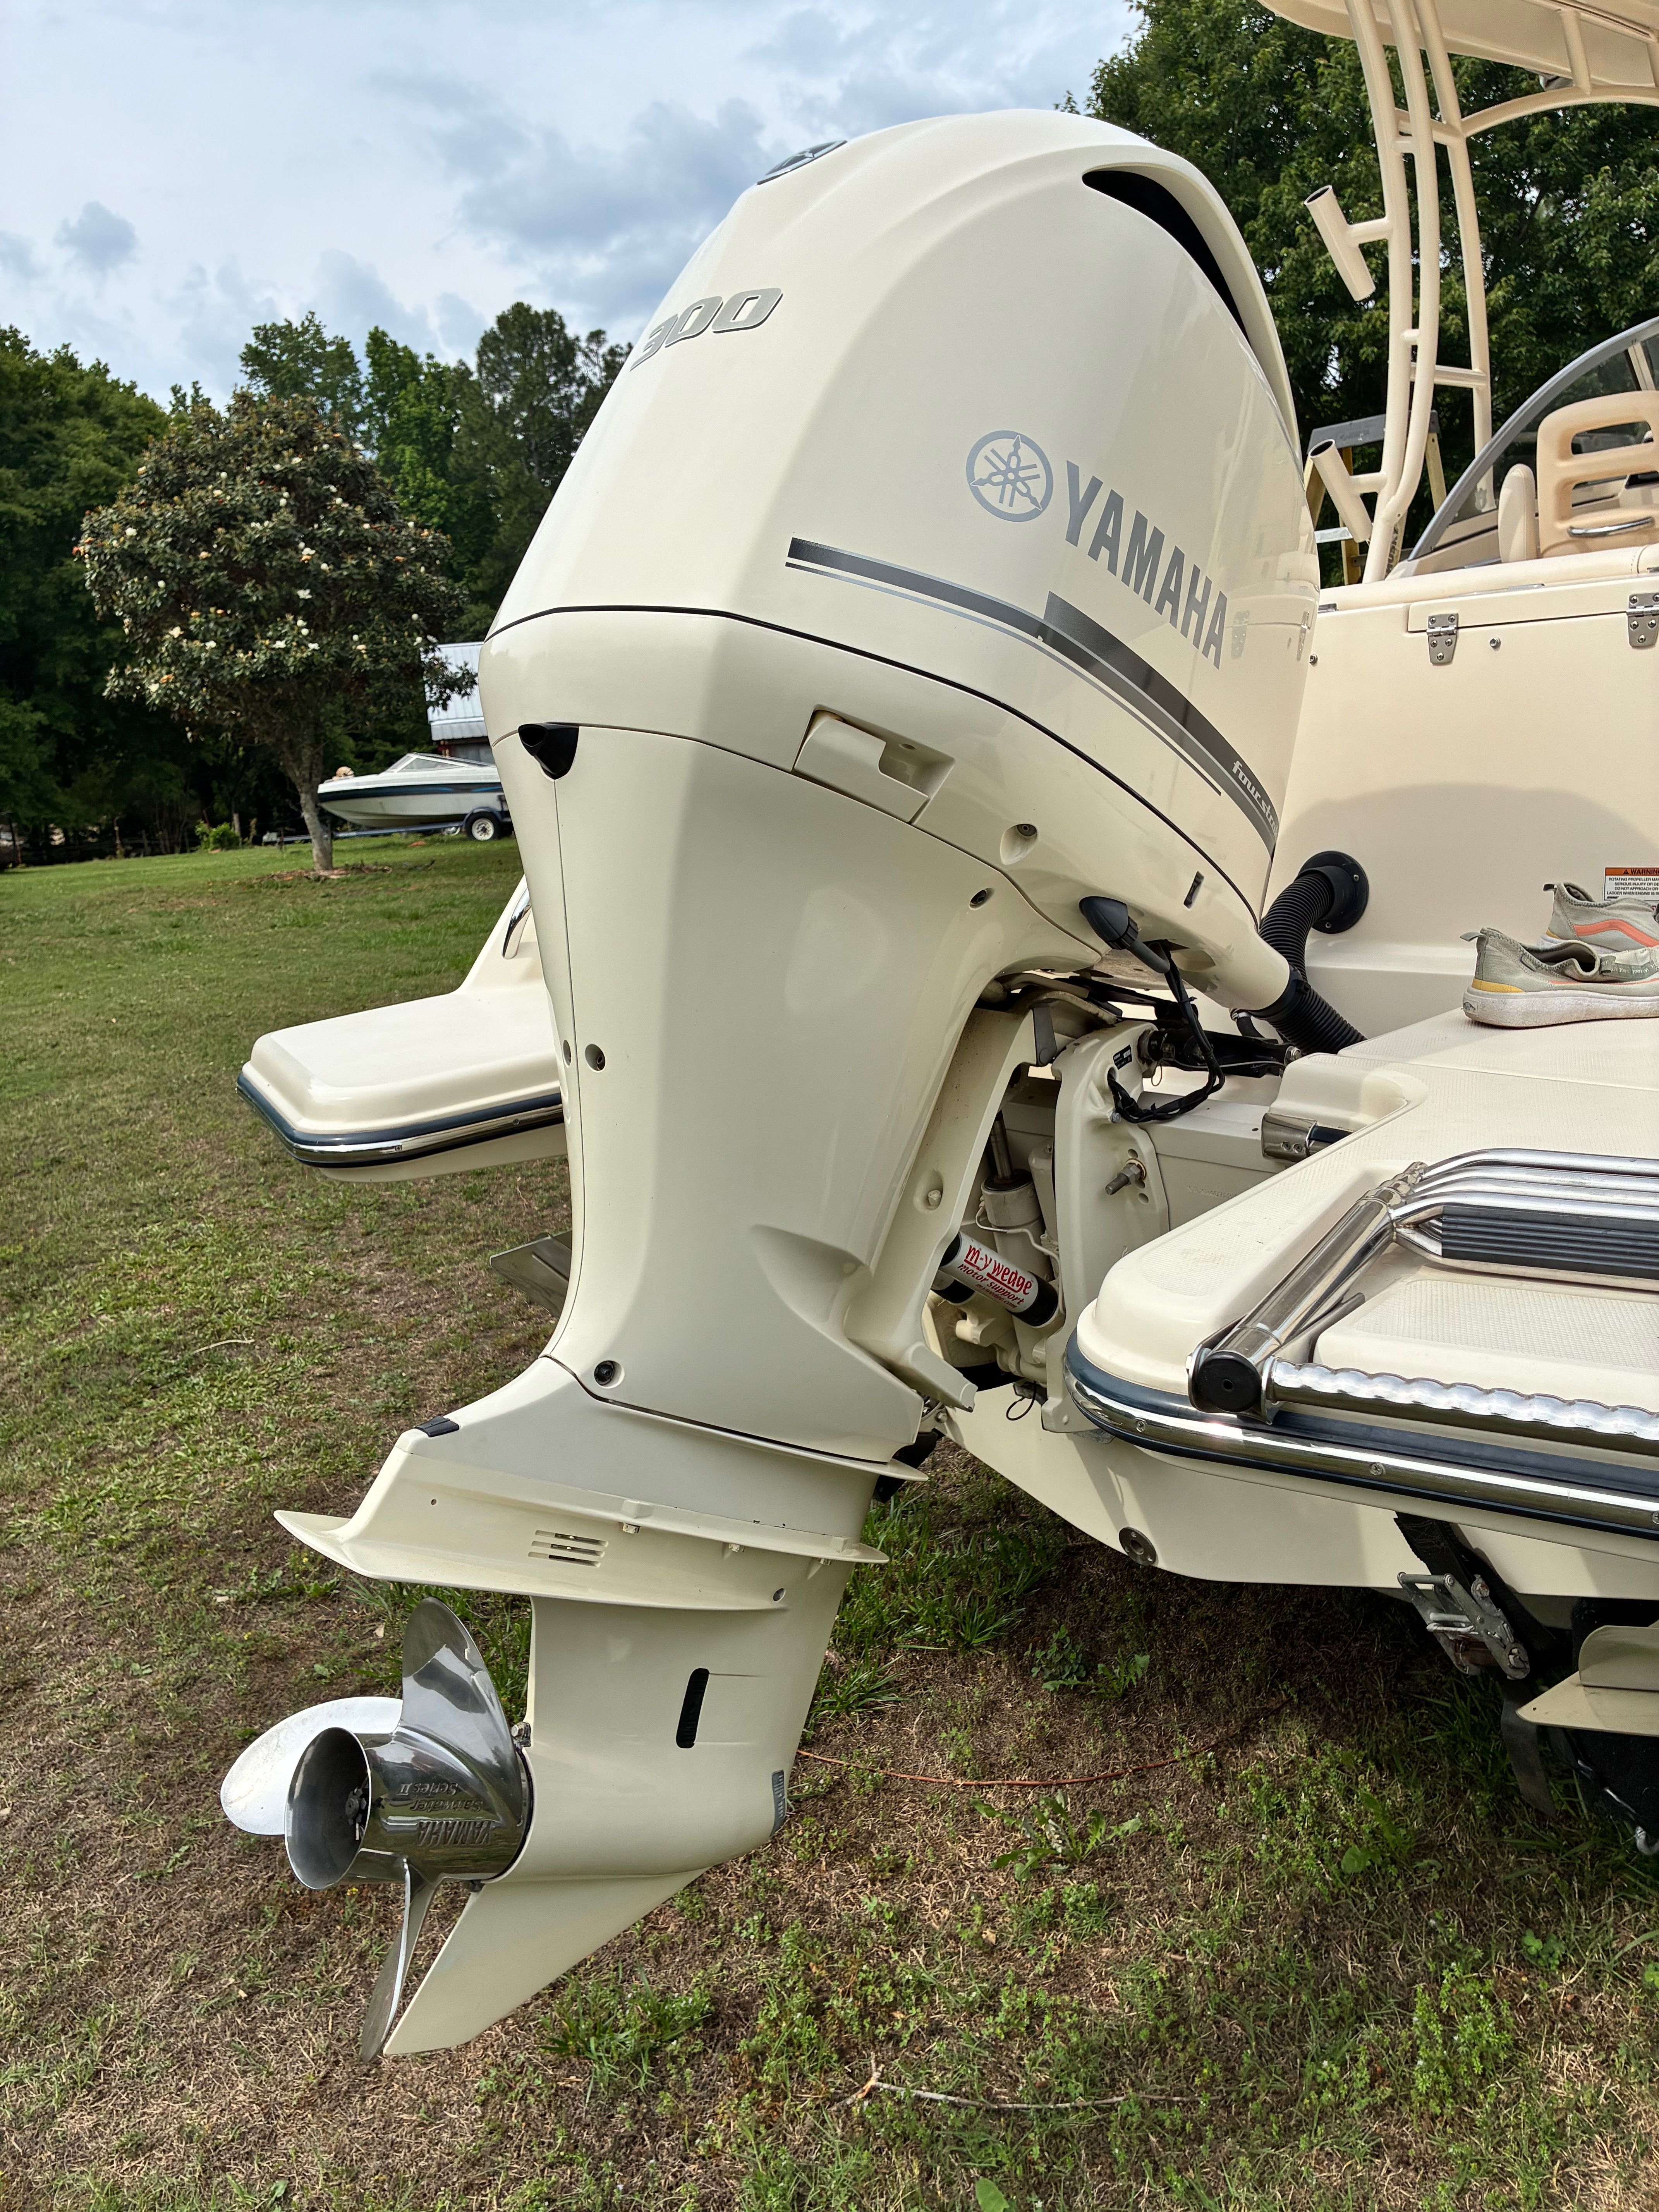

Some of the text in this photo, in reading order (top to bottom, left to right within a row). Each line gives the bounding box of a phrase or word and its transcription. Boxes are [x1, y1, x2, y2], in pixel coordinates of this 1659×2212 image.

[630, 287, 783, 372] 300
[1065, 460, 1228, 670] YAMAHA
[957, 1264, 1025, 1305] motor support
[986, 1259, 1032, 1295] wedge
[412, 1782, 458, 1796] Series
[417, 1820, 491, 1847] YAMAHA
